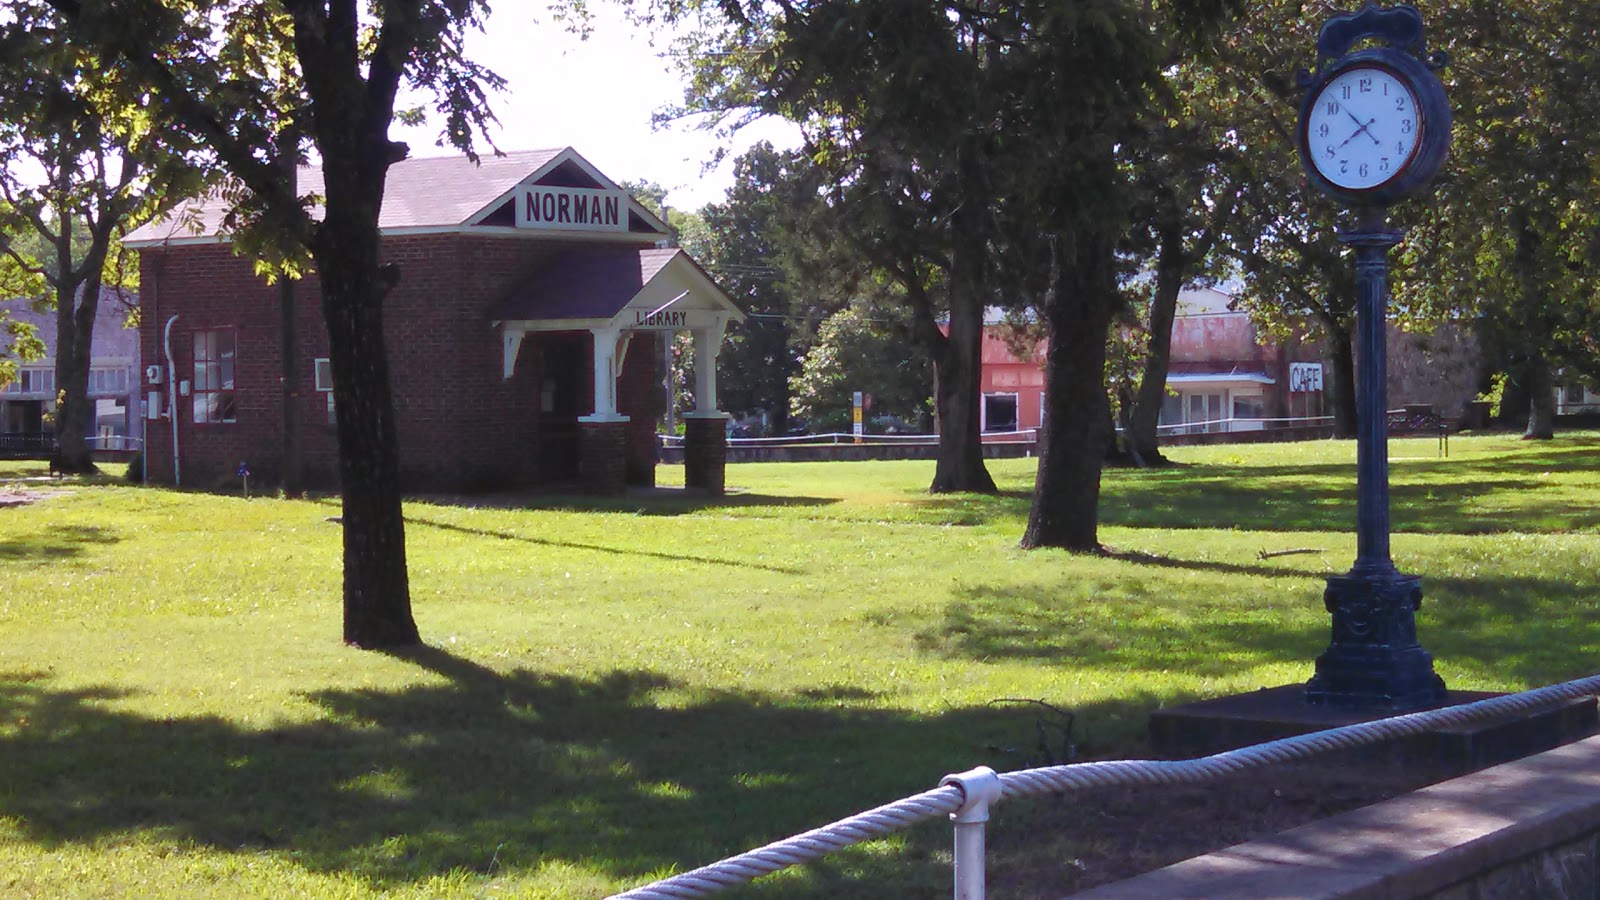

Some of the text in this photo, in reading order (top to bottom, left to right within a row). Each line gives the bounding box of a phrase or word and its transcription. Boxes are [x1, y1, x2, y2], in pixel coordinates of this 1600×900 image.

[1342, 86, 1351, 99] 11
[1360, 78, 1372, 93] 12
[1383, 82, 1388, 96] 1
[1327, 101, 1340, 116] 10
[1395, 98, 1405, 112] 2
[1319, 123, 1329, 138] 9
[1401, 119, 1412, 134] 3
[1326, 145, 1336, 159] 8
[1339, 160, 1349, 174] 7
[1359, 163, 1369, 178] 6
[1379, 157, 1389, 171] 5
[526, 191, 619, 225] NORMAN
[635, 310, 687, 327] LIBRARY
[1291, 367, 1320, 392] CAFE
